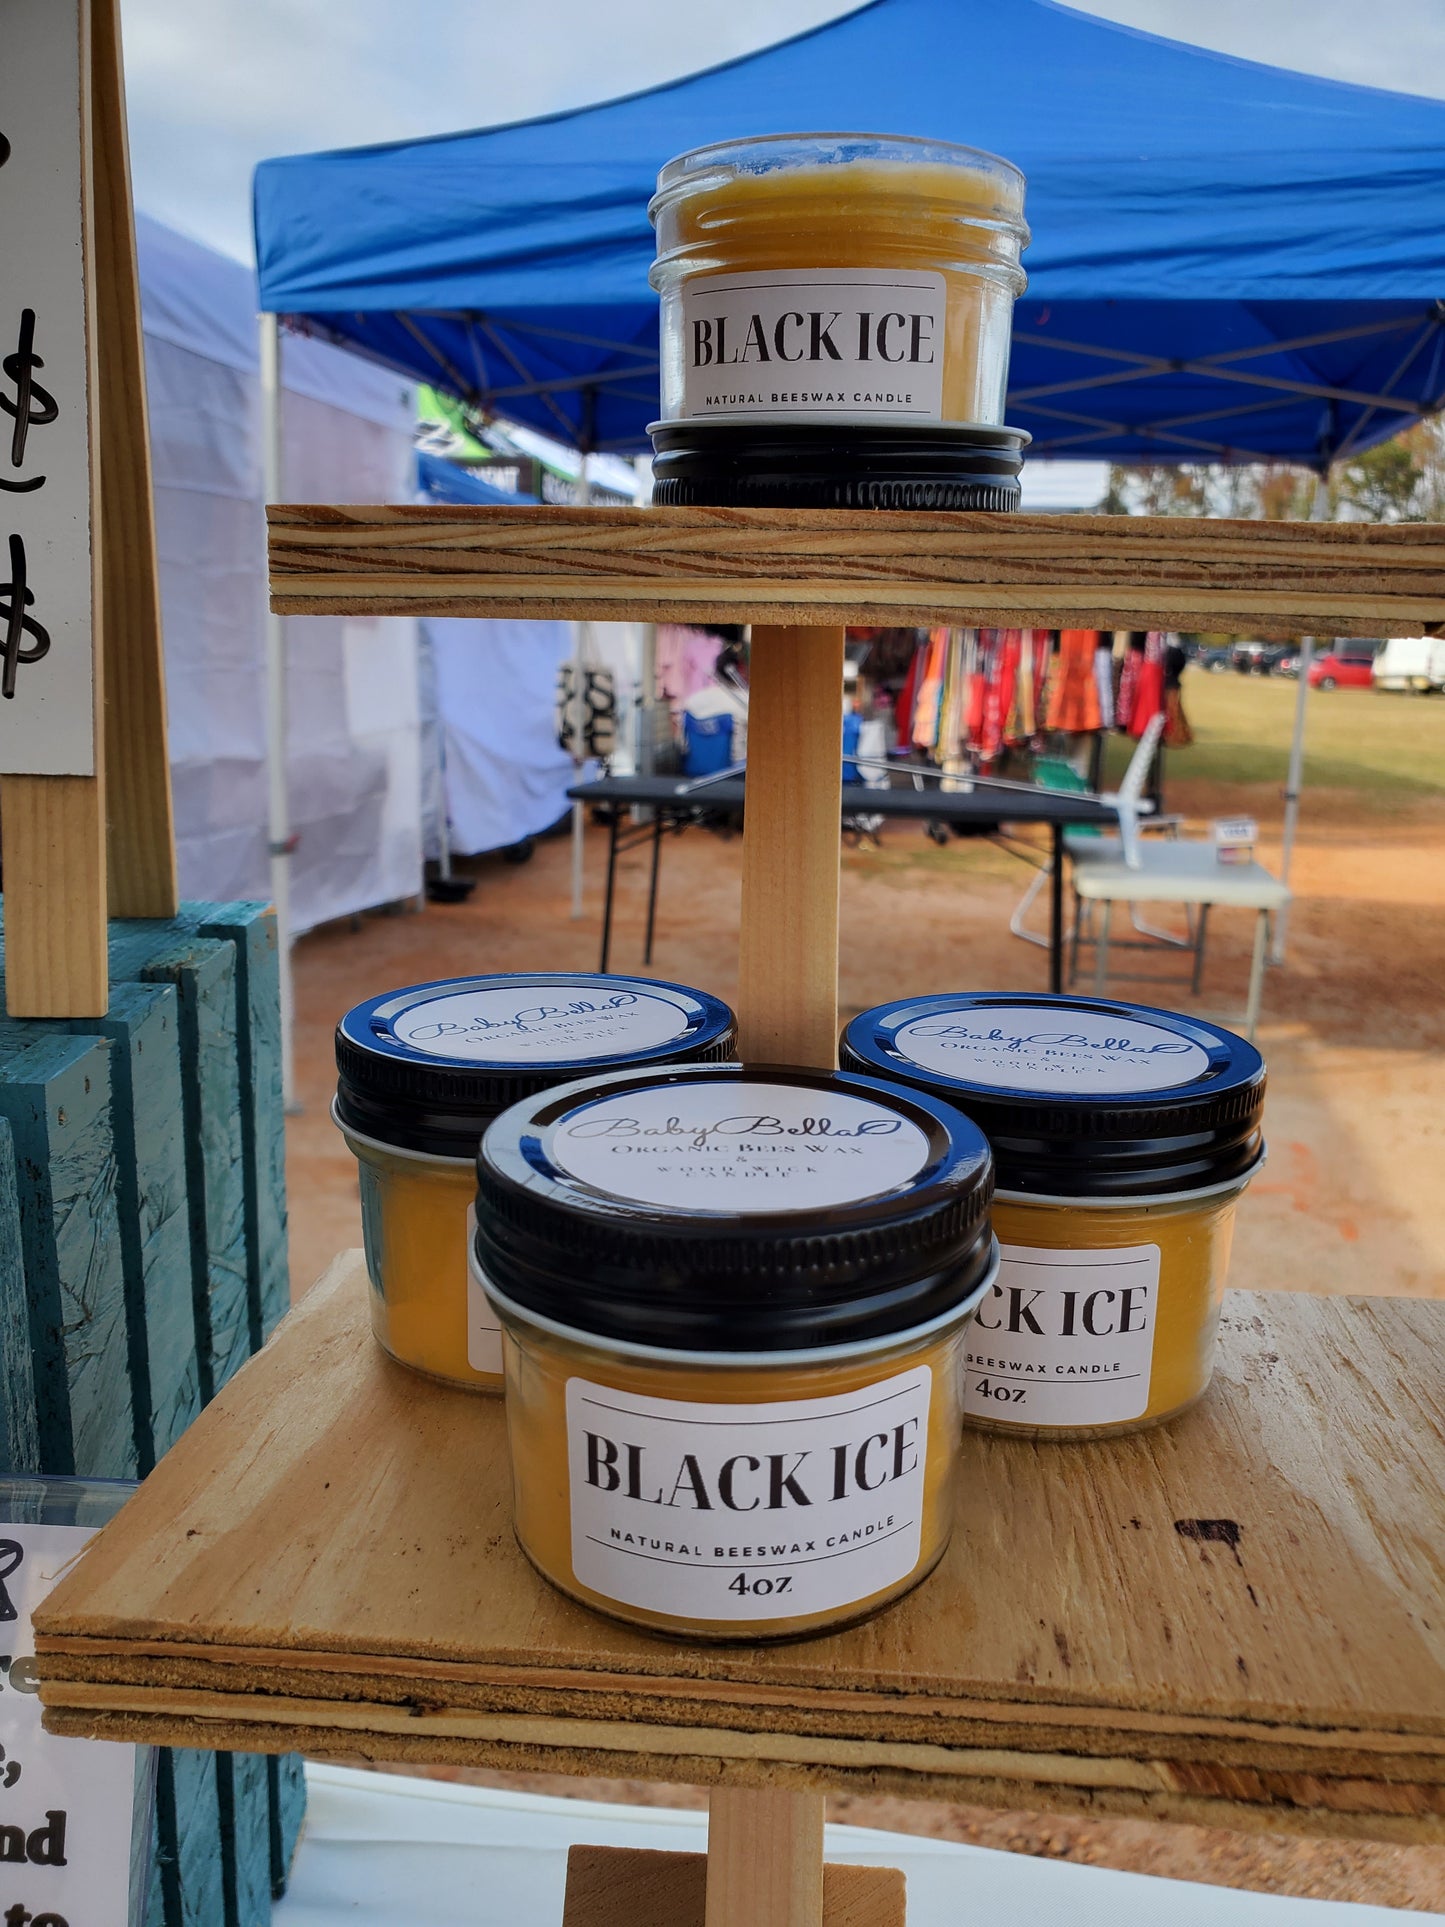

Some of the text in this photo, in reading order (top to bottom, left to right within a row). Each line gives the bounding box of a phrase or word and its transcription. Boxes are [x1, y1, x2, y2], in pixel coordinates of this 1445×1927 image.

[692, 312, 934, 367] BLACK ICE
[706, 392, 912, 405] NATURAL BEESWAX CANDLE
[1057, 1286, 1147, 1336] ICE
[967, 1353, 1121, 1374] BEESWAX CANDLE
[975, 1378, 1027, 1404] 4oz
[583, 1417, 919, 1511] BLACK ICE
[610, 1514, 895, 1557] NATURAL BEESWAX CANDLE
[728, 1573, 793, 1597] 4oz
